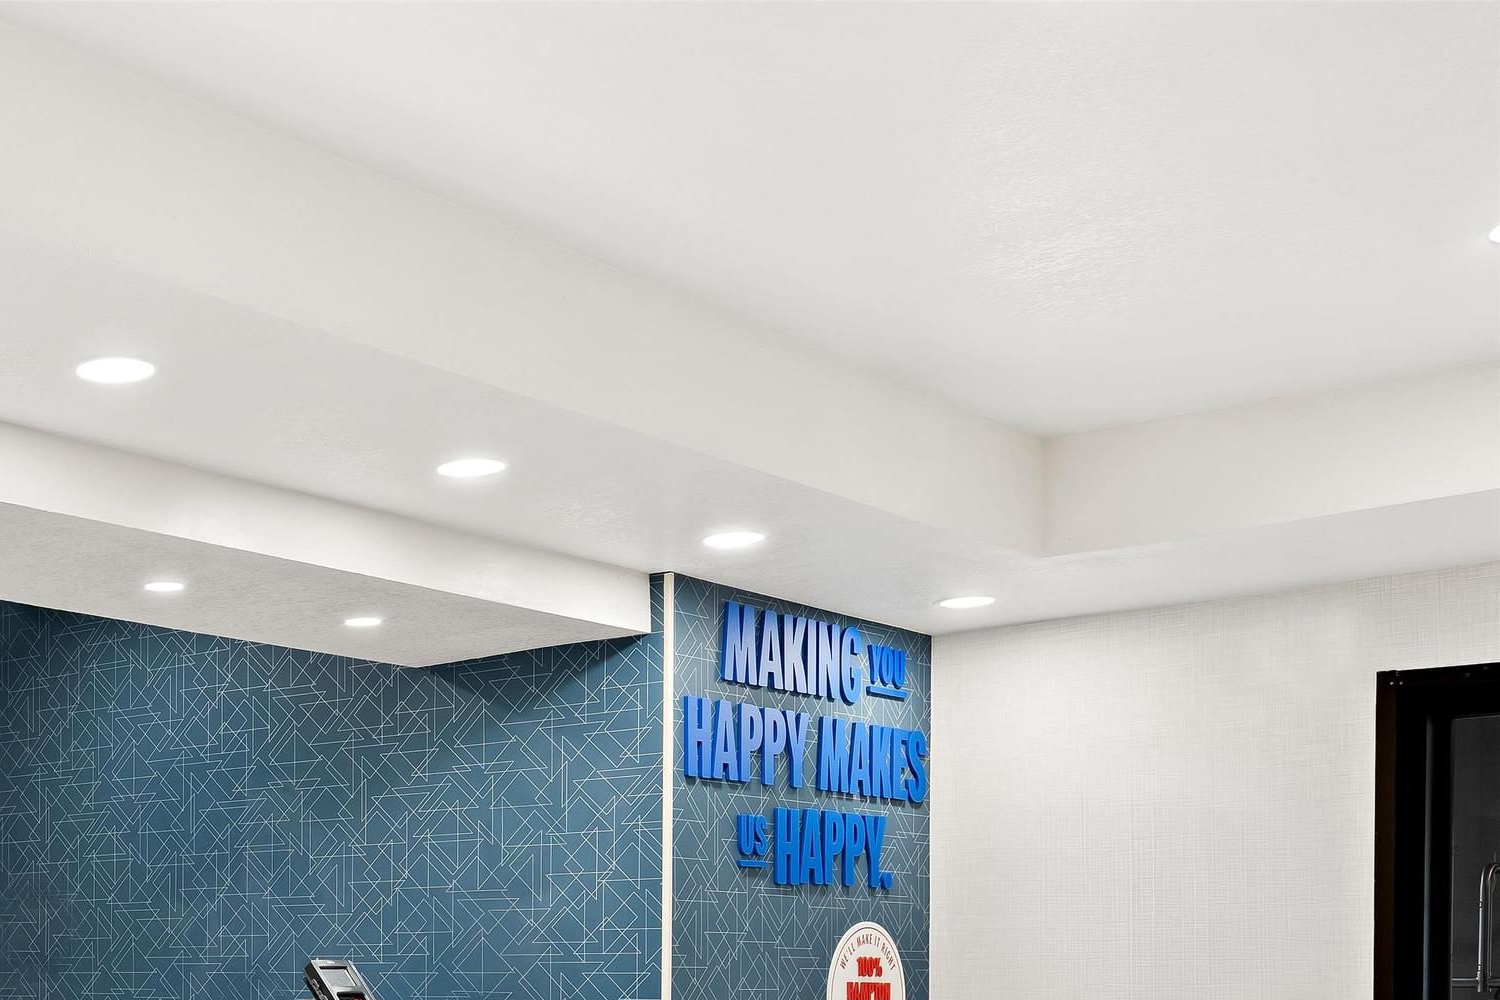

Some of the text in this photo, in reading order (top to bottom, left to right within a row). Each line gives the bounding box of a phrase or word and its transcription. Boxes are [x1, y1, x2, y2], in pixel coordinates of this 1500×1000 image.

[721, 601, 906, 706] MAKING YOU
[684, 695, 927, 803] HAPPY MAKES
[737, 807, 892, 889] US HAPPY.
[856, 933, 873, 946] MAKE
[874, 936, 881, 948] IT
[881, 943, 896, 970] RIGHT
[856, 956, 883, 977] 100%
